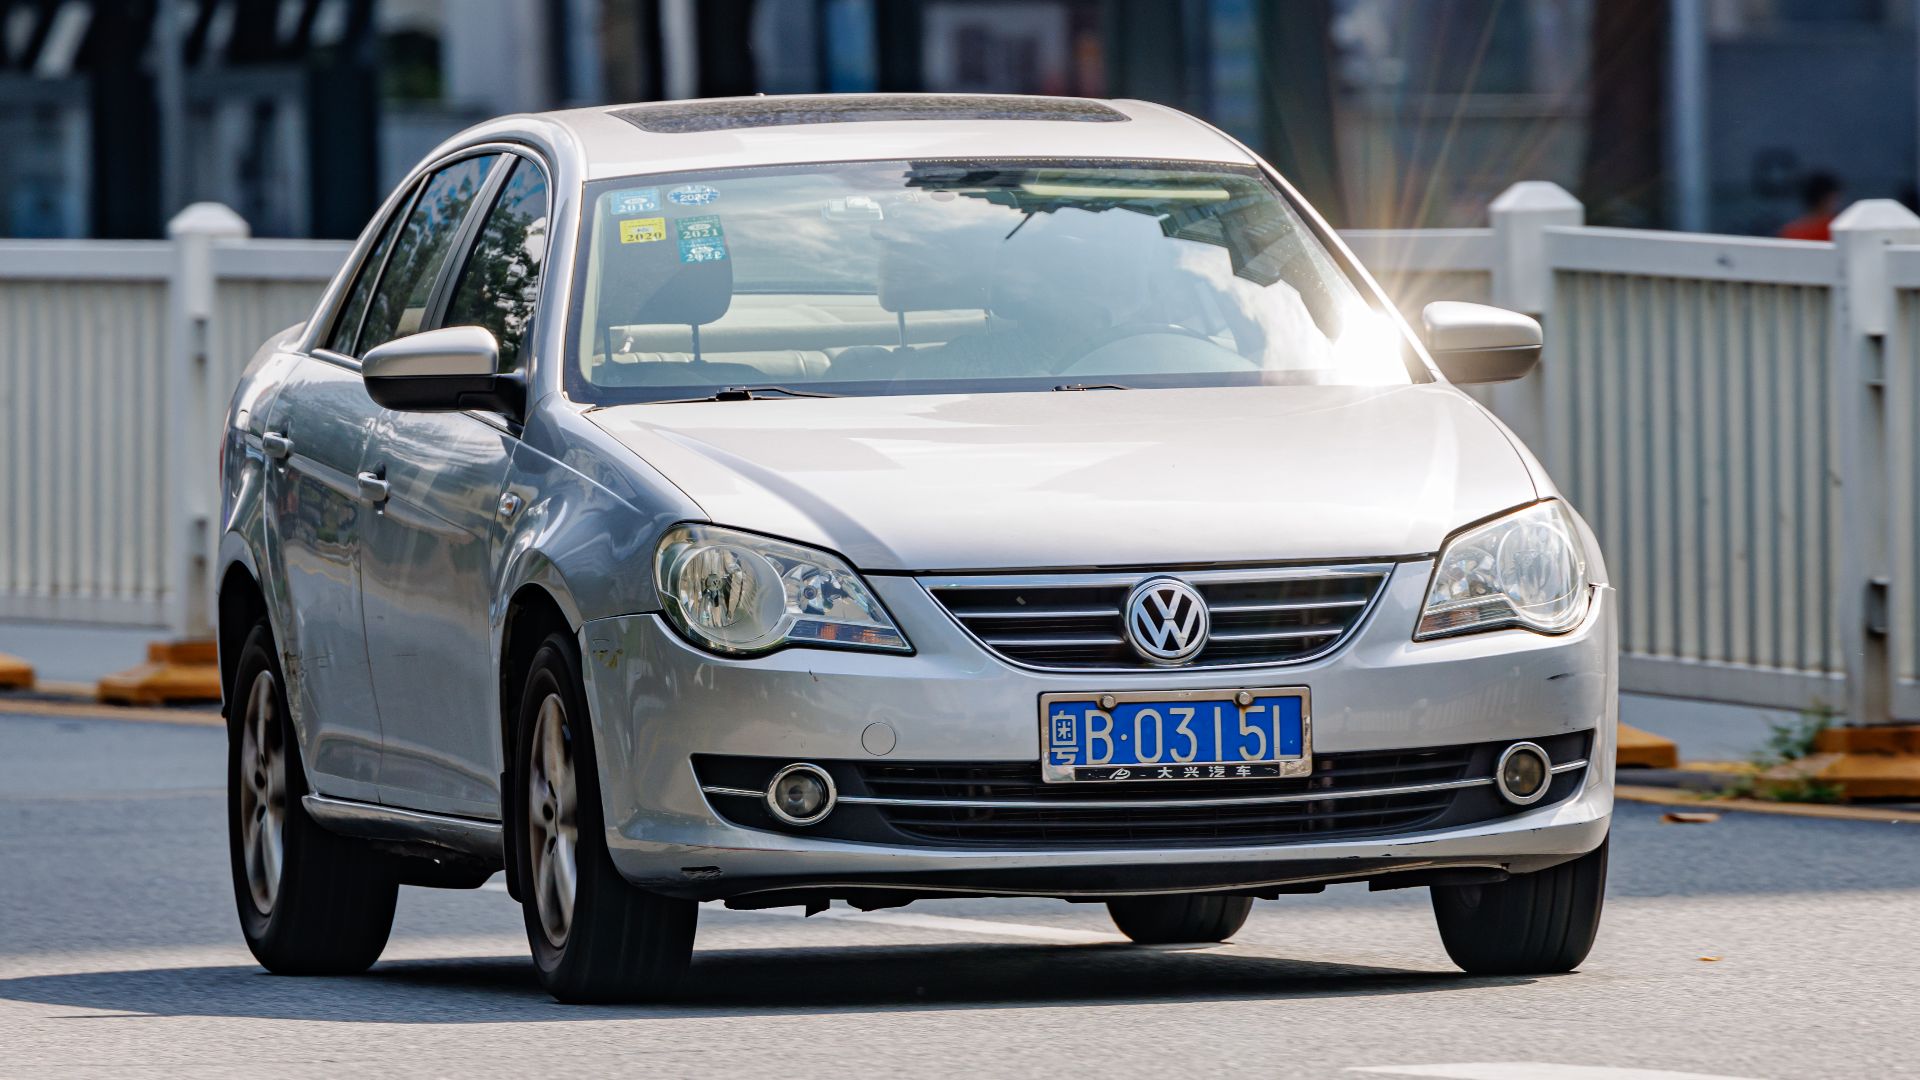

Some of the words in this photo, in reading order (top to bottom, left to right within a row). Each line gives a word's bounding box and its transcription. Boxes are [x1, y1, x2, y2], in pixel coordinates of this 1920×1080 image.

[619, 202, 655, 212] 2019
[627, 232, 662, 242] 2020
[683, 229, 719, 239] 2021
[1157, 766, 1252, 779] 大兴汽车
